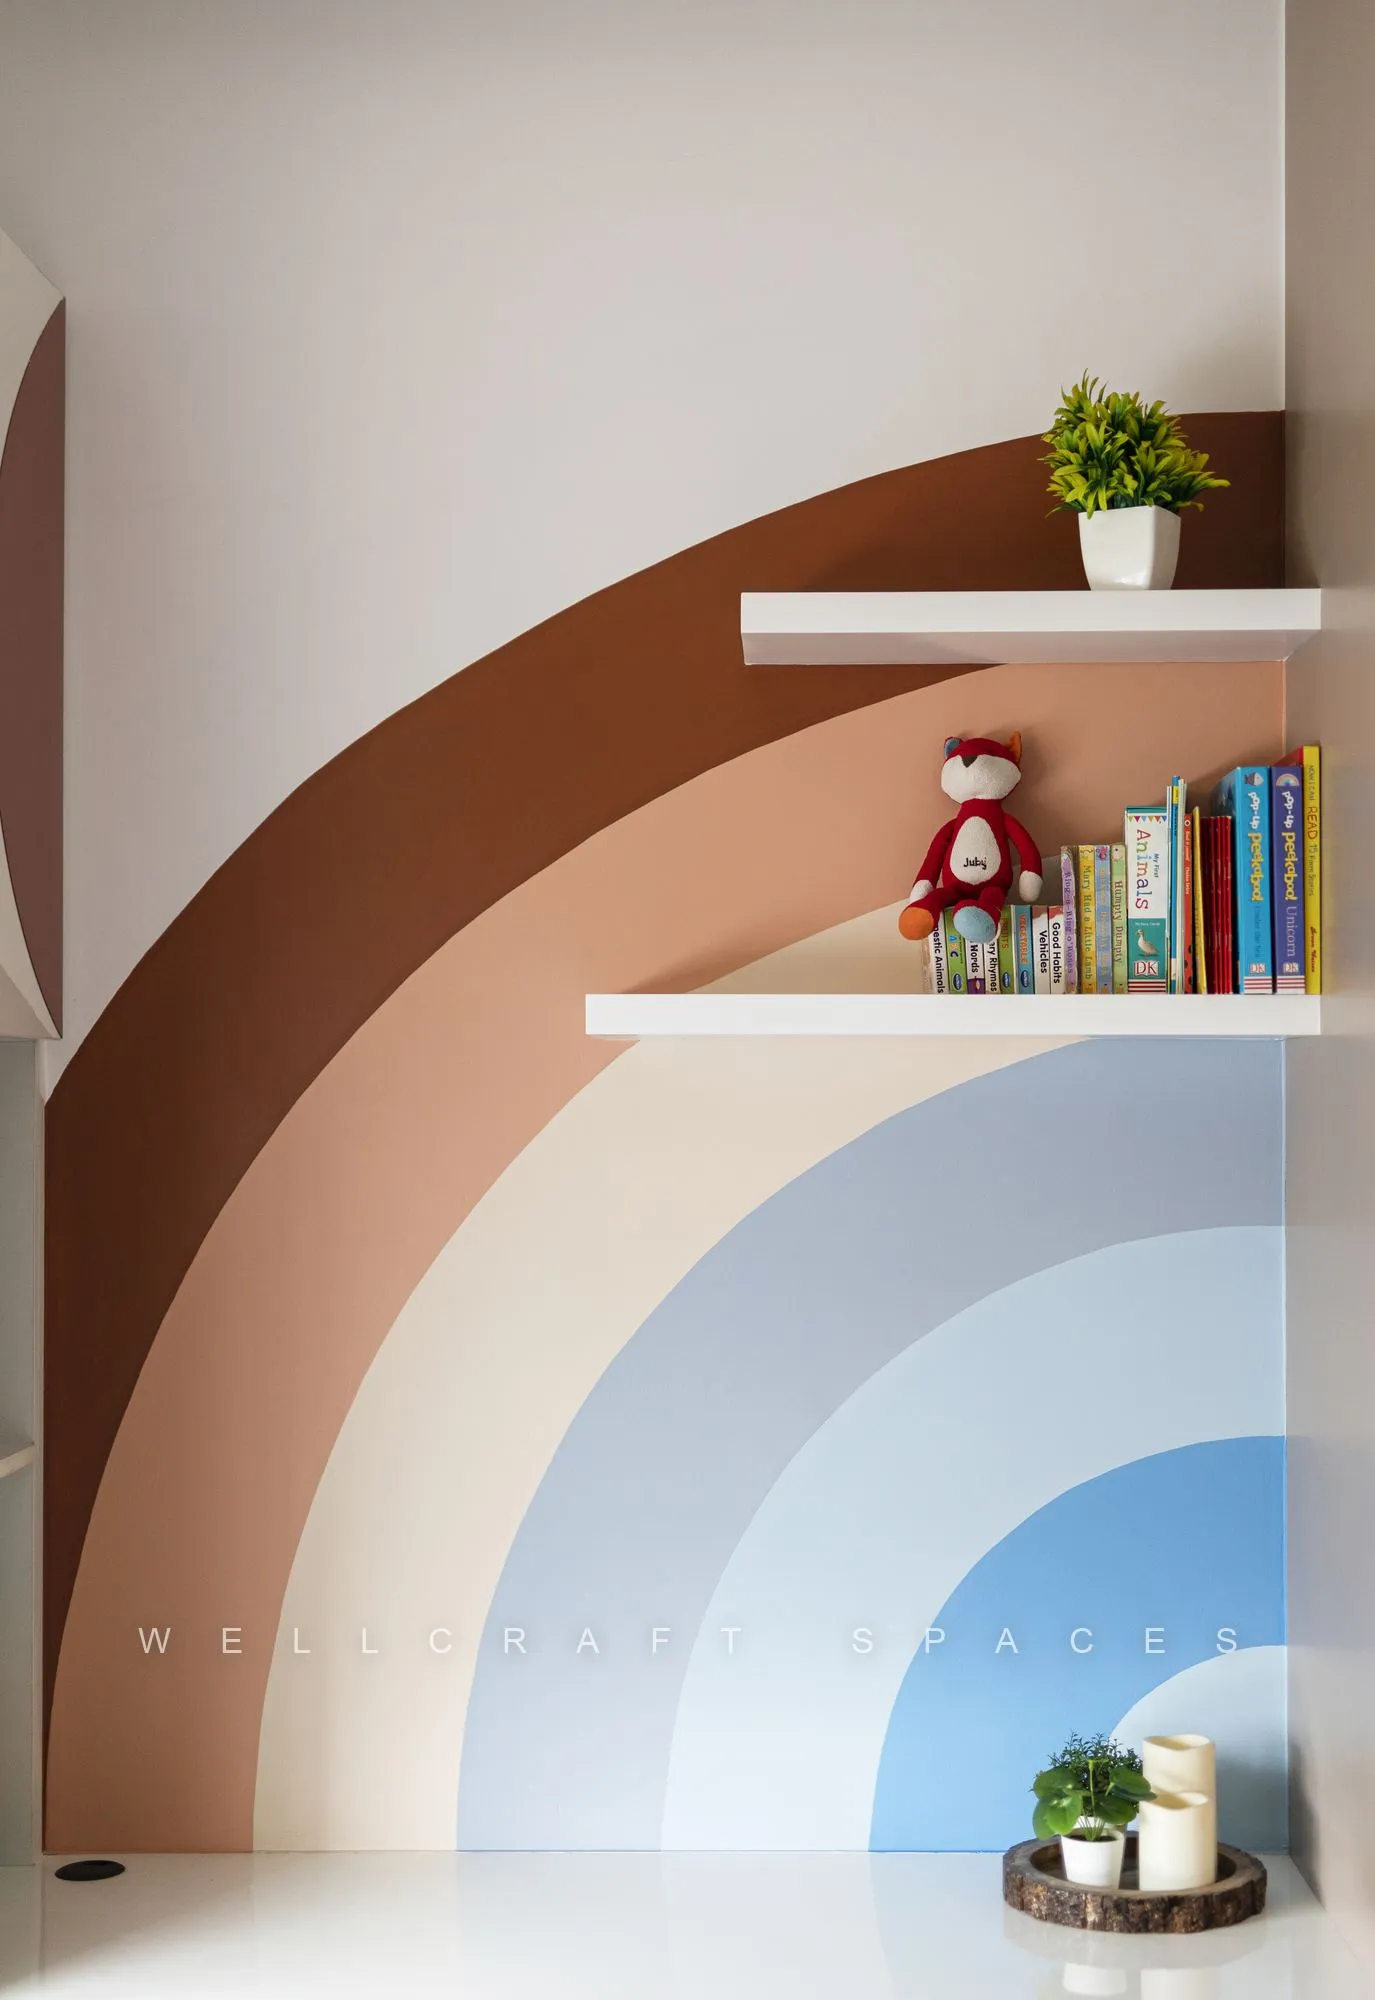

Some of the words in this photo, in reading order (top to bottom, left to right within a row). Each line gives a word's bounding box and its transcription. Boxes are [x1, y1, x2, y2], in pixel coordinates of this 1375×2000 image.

[1248, 791, 1261, 829] pop-up
[1282, 791, 1294, 828] pop-up
[1307, 806, 1318, 840] READ
[1135, 829, 1152, 910] Animals
[1153, 853, 1160, 863] My
[1248, 832, 1264, 901] peekaboo!
[1282, 832, 1298, 901] peekaboo!
[1082, 865, 1091, 890] Mary
[1083, 895, 1092, 912] Had
[1113, 881, 1123, 921] Humpty
[1052, 922, 1061, 949] Good
[1084, 926, 1093, 952] Little
[1114, 926, 1123, 964] Dumpty
[1286, 906, 1298, 957] Unicorn
[970, 944, 980, 973] Words
[1039, 930, 1049, 974] Vehicles
[1052, 951, 1063, 984] Habits
[1085, 956, 1093, 980] Lamb
[1136, 962, 1157, 975] DK
[935, 956, 945, 994] Animals
[989, 957, 998, 992] Rhymes
